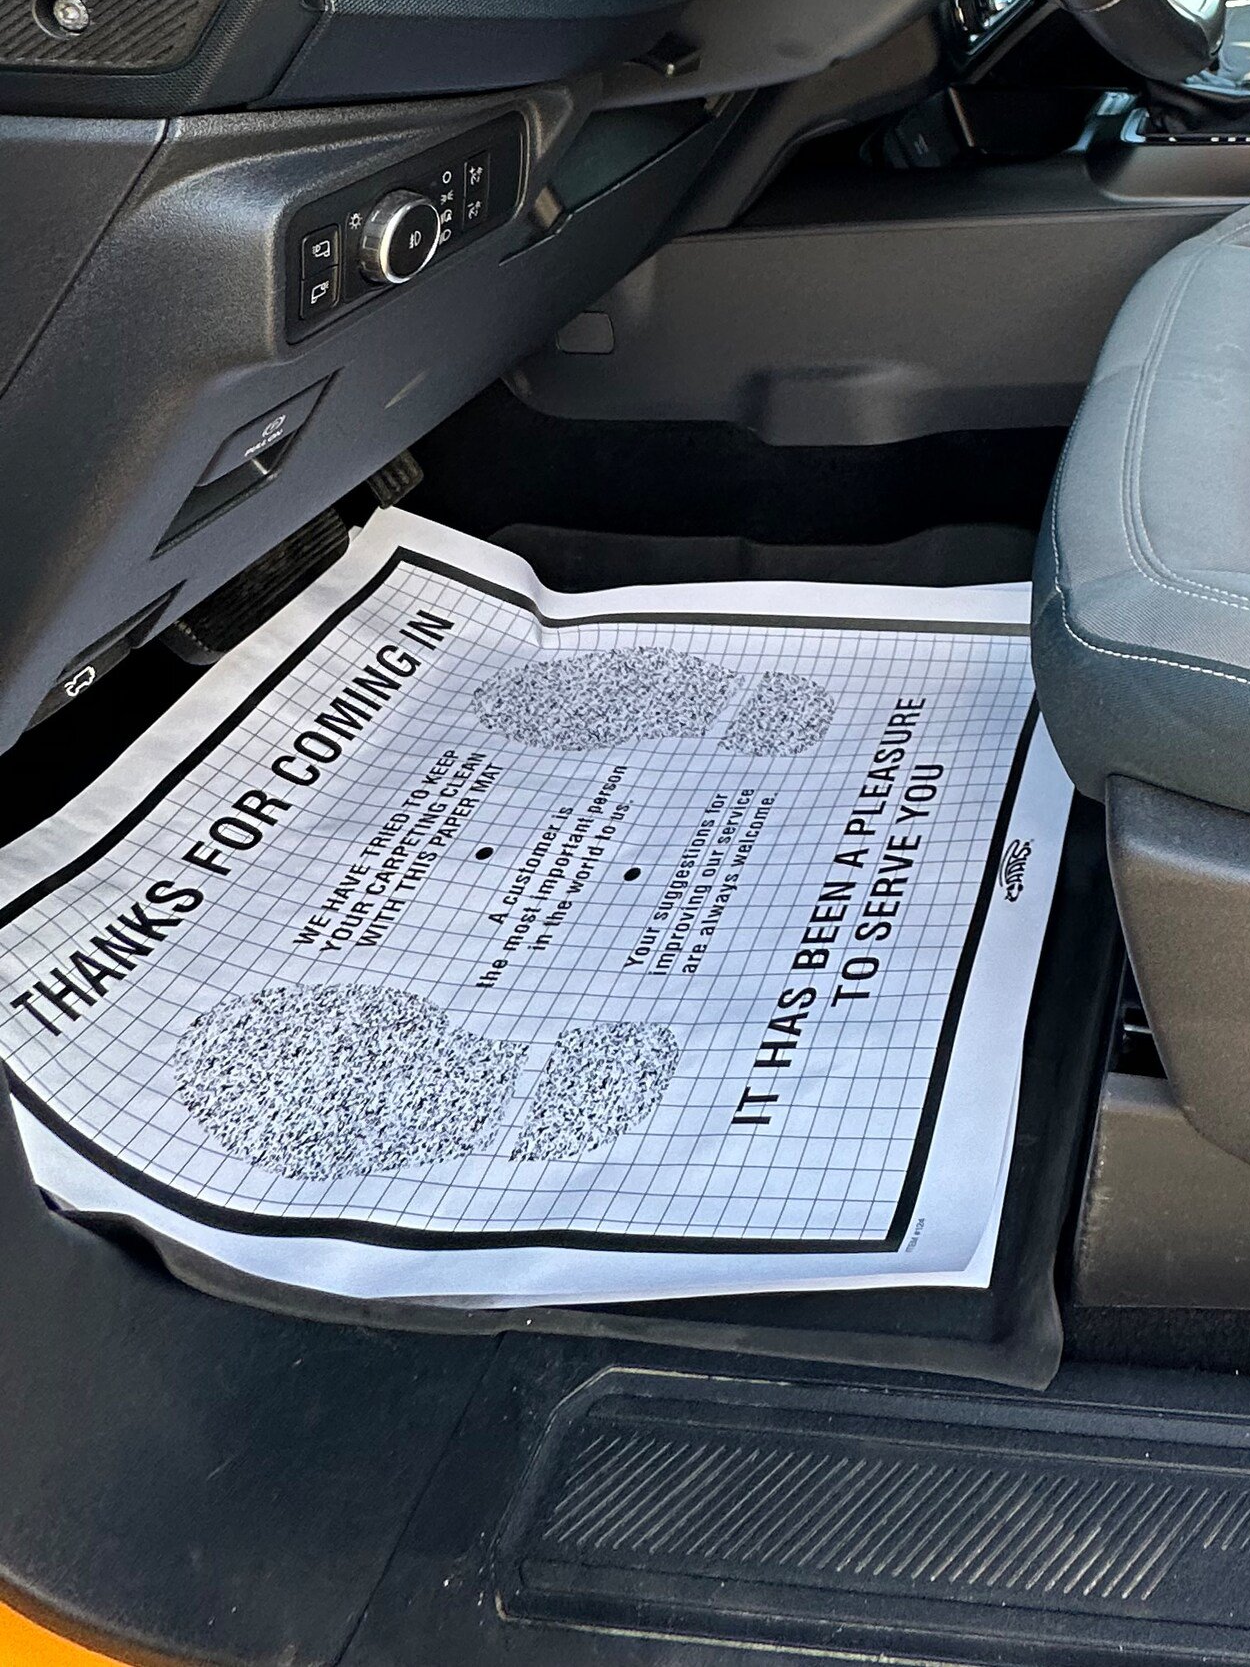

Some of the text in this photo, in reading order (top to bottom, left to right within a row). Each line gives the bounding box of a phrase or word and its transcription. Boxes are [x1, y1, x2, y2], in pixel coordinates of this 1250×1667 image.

[10, 609, 455, 1036] THANKS FOR COMING IN
[293, 750, 459, 945] WE HAVE TRIED TO KEEP
[320, 752, 487, 952] YOUR CARPETING CLEAN
[355, 763, 503, 947] WITH THIS PAPER MAT
[476, 765, 628, 988] the most important person
[488, 806, 573, 925] A customer is
[527, 799, 634, 951] in the world to us.
[624, 793, 728, 968] Your suggestions for
[649, 789, 754, 975] improving our service
[682, 792, 778, 974] are always welcome.
[731, 696, 927, 1124] IT HAS BEEN A PLEASURE
[831, 763, 945, 1007] TO SERVE YOU
